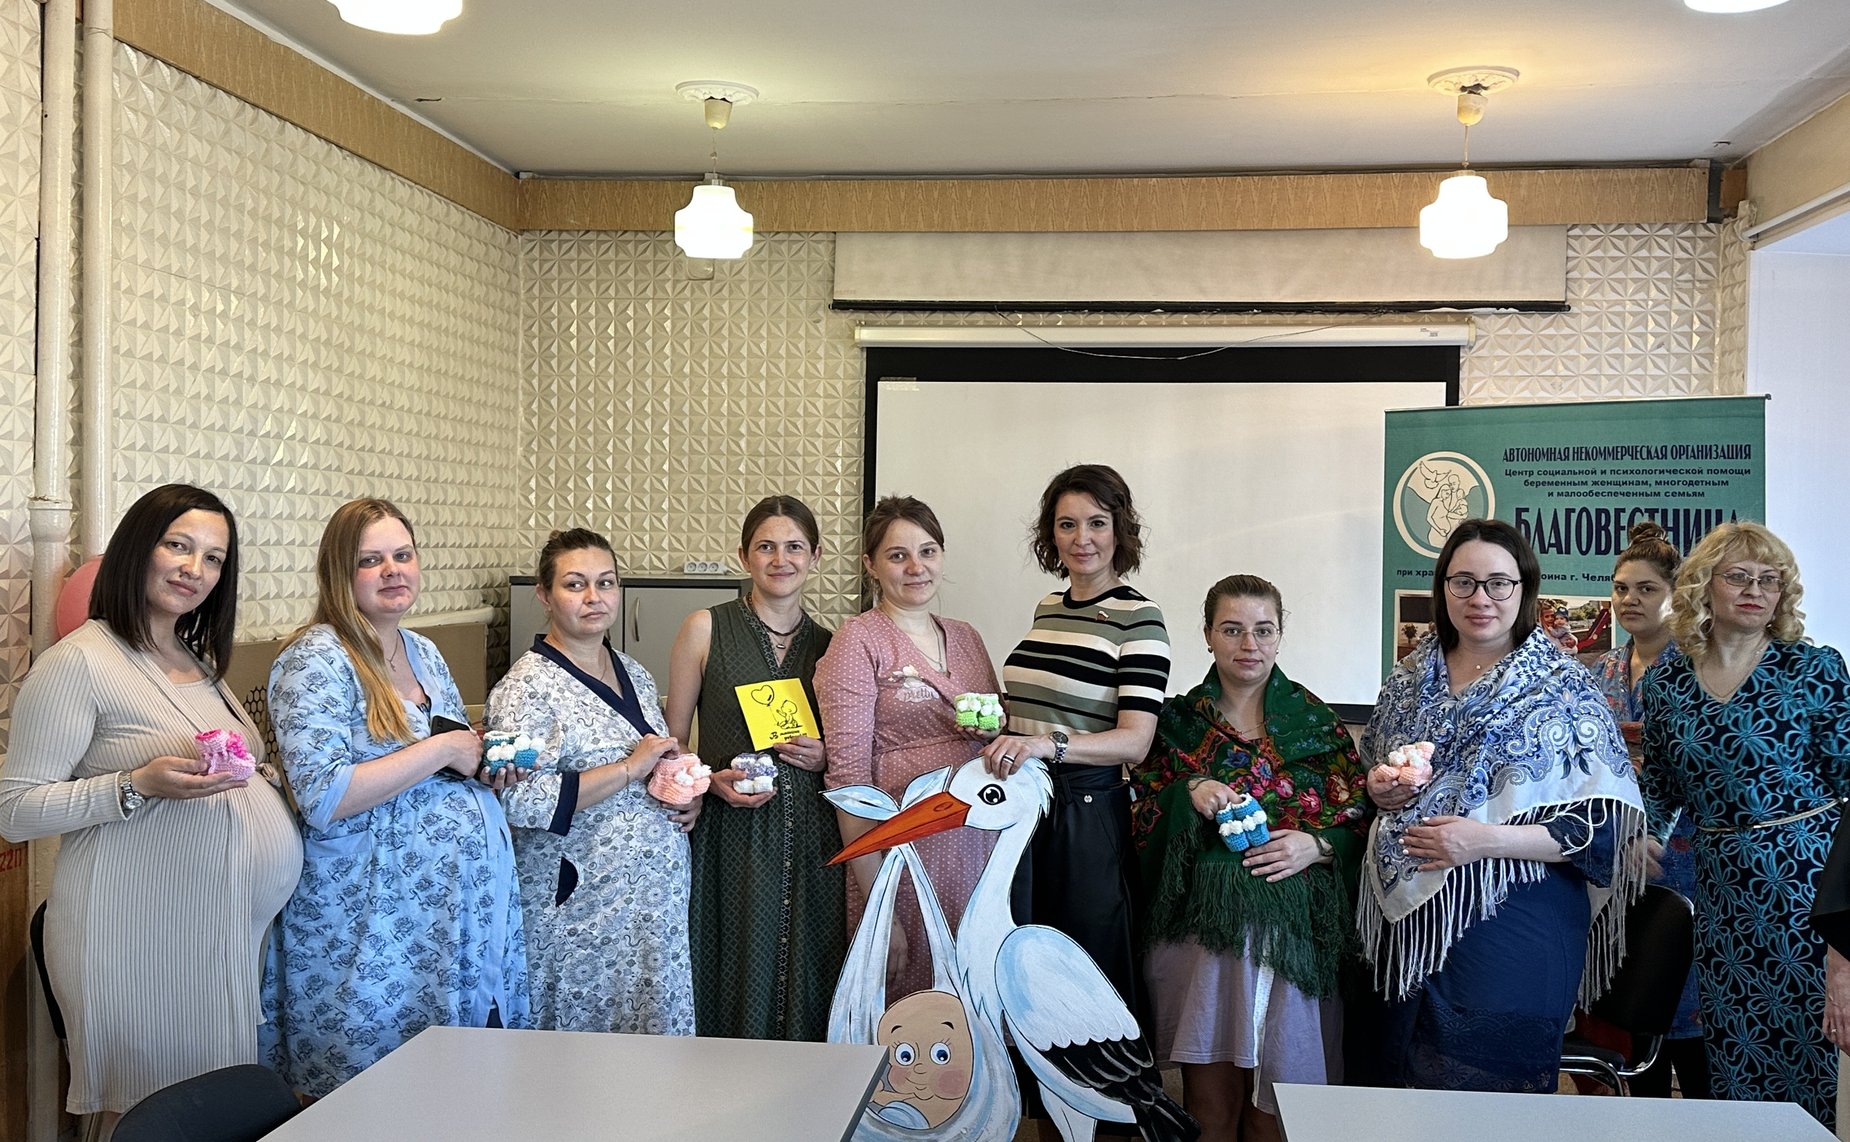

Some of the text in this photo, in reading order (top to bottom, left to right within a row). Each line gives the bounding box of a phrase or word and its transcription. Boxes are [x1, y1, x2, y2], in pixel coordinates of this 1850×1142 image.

[1503, 444, 1752, 462] АВТОНОМНАЯ НЕКОММЕРЧЕСКАЯ ОРГАНИЗАЦИЯ
[1504, 468, 1534, 477] Центр
[1537, 467, 1597, 477] социальной
[1609, 466, 1704, 476] психологической
[1706, 468, 1751, 476] помощи
[1523, 479, 1729, 488] беременным женщинам, многодетным
[1547, 489, 1705, 498] и малообеспеченным семьям
[1514, 506, 1739, 557] БЛАГОВЕСНИ
[1396, 569, 1434, 578] при хра
[1540, 573, 1568, 581] оина
